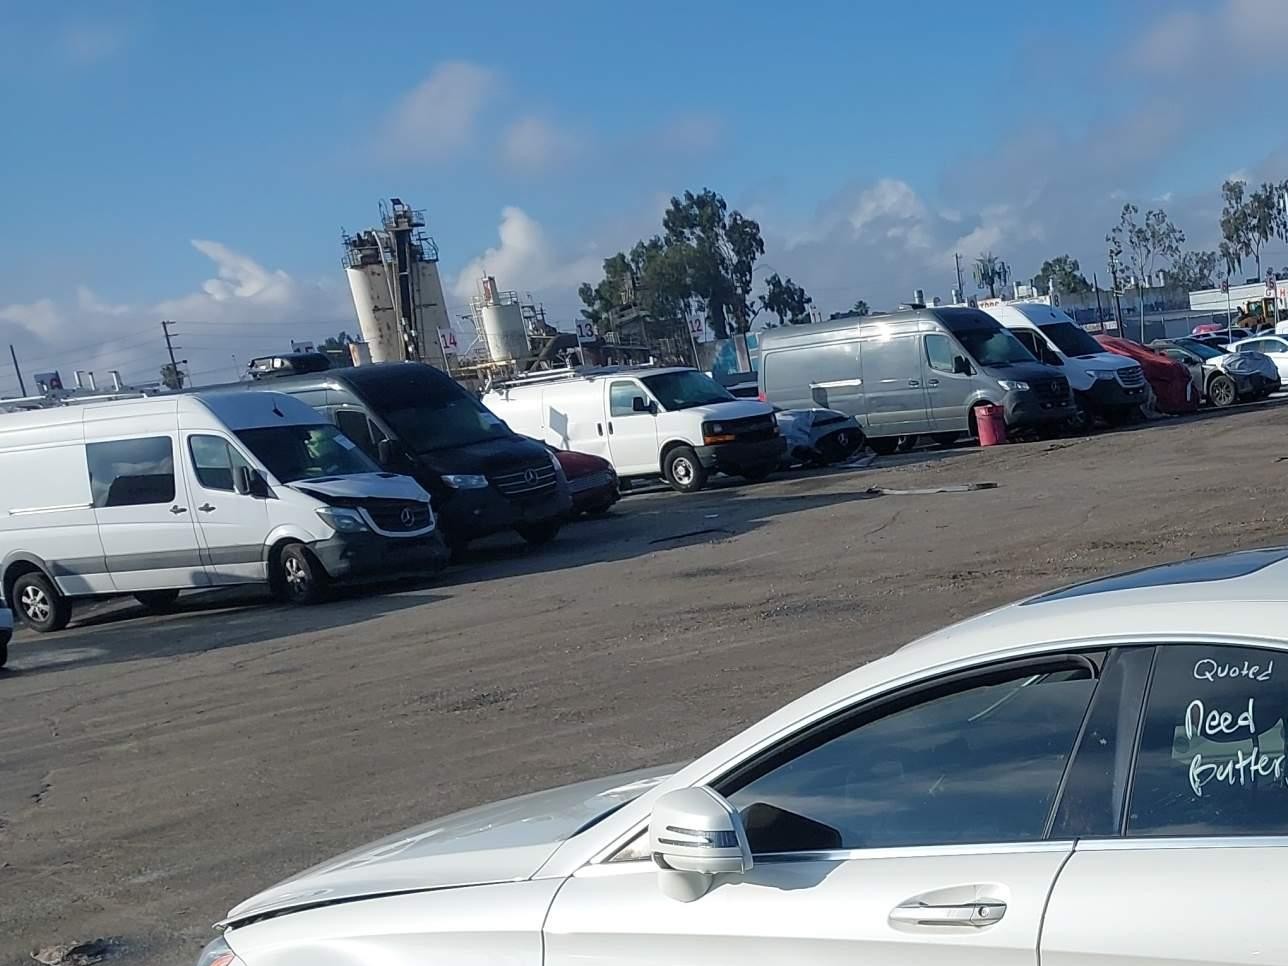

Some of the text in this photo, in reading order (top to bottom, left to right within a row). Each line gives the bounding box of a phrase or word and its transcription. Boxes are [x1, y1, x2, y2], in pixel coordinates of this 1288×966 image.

[577, 322, 594, 338] 13
[689, 318, 703, 334] 12
[440, 333, 457, 349] 14
[1194, 658, 1273, 682] Quoted
